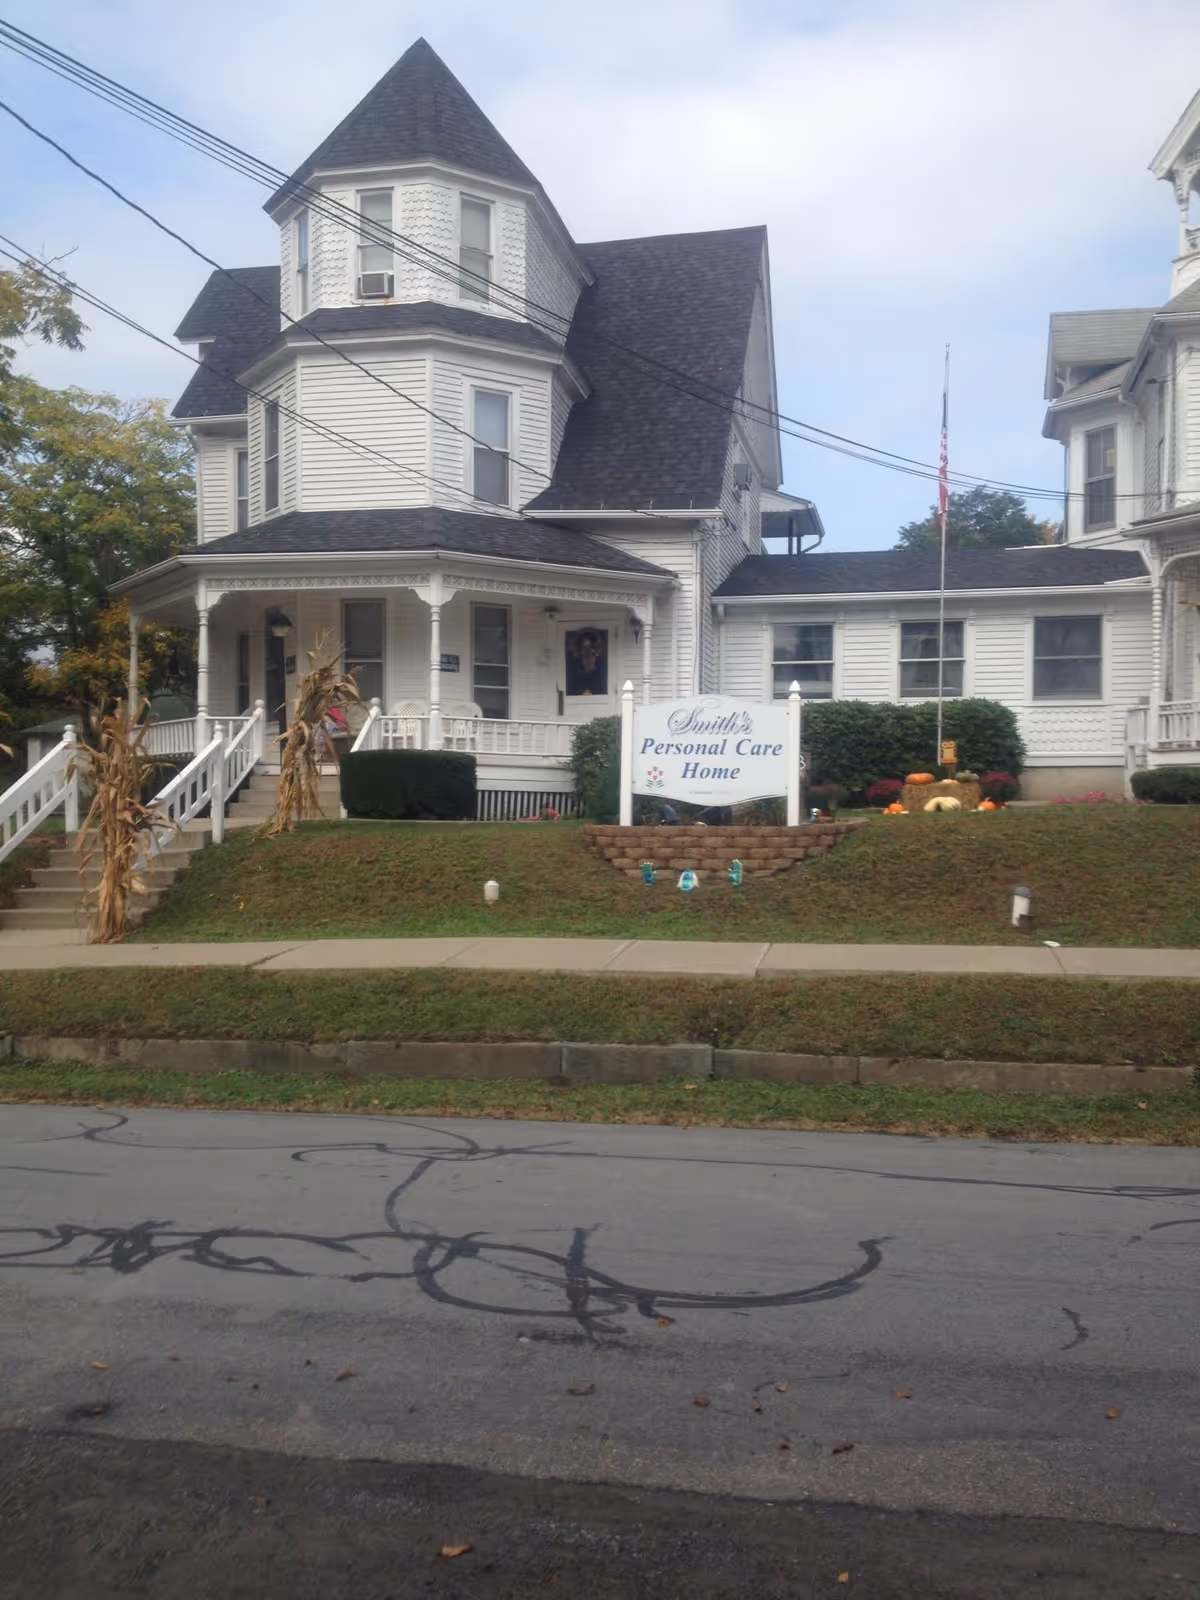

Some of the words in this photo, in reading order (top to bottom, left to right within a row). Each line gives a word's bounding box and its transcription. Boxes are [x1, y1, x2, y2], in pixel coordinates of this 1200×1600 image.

[640, 738, 727, 756] Personal
[735, 738, 783, 756] Care
[681, 762, 741, 779] Home
